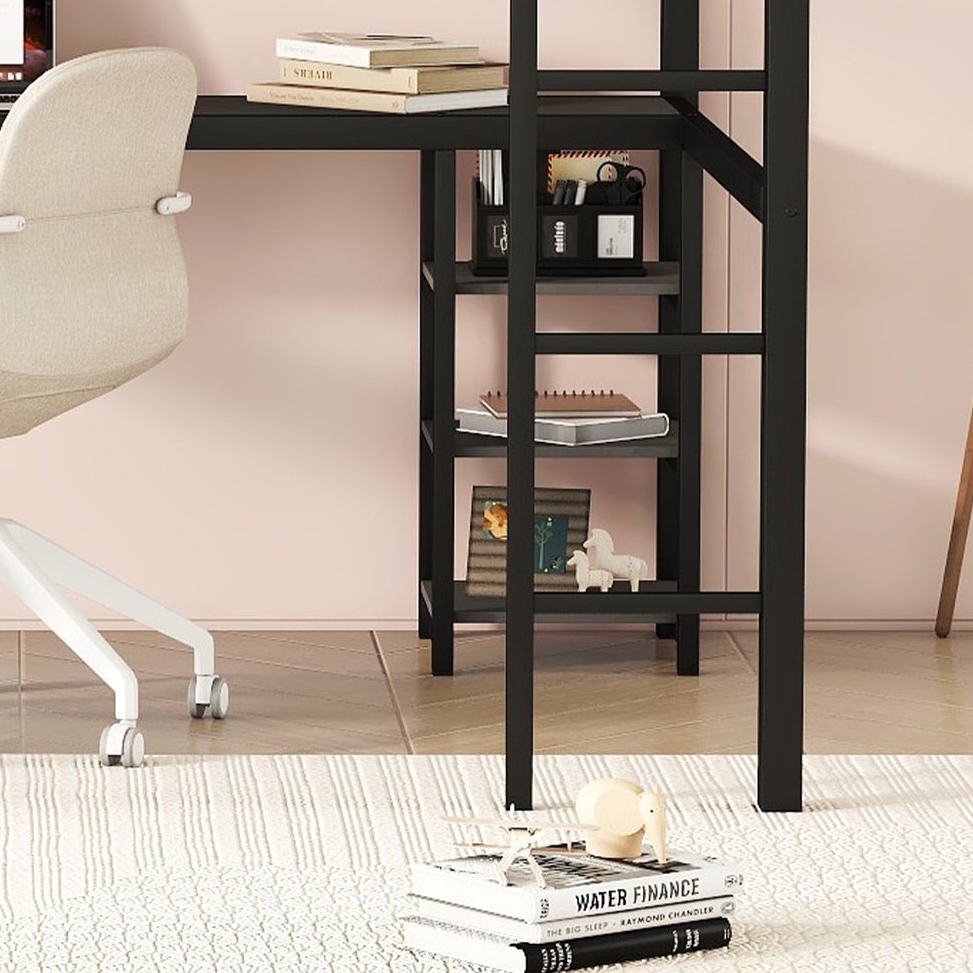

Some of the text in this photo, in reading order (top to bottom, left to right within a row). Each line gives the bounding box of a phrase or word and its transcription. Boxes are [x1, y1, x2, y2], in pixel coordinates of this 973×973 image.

[575, 888, 627, 912] WATER
[633, 877, 699, 904] FINANCE
[546, 906, 714, 937] THE BIG SLEEP RAYMOND CHANDLER
